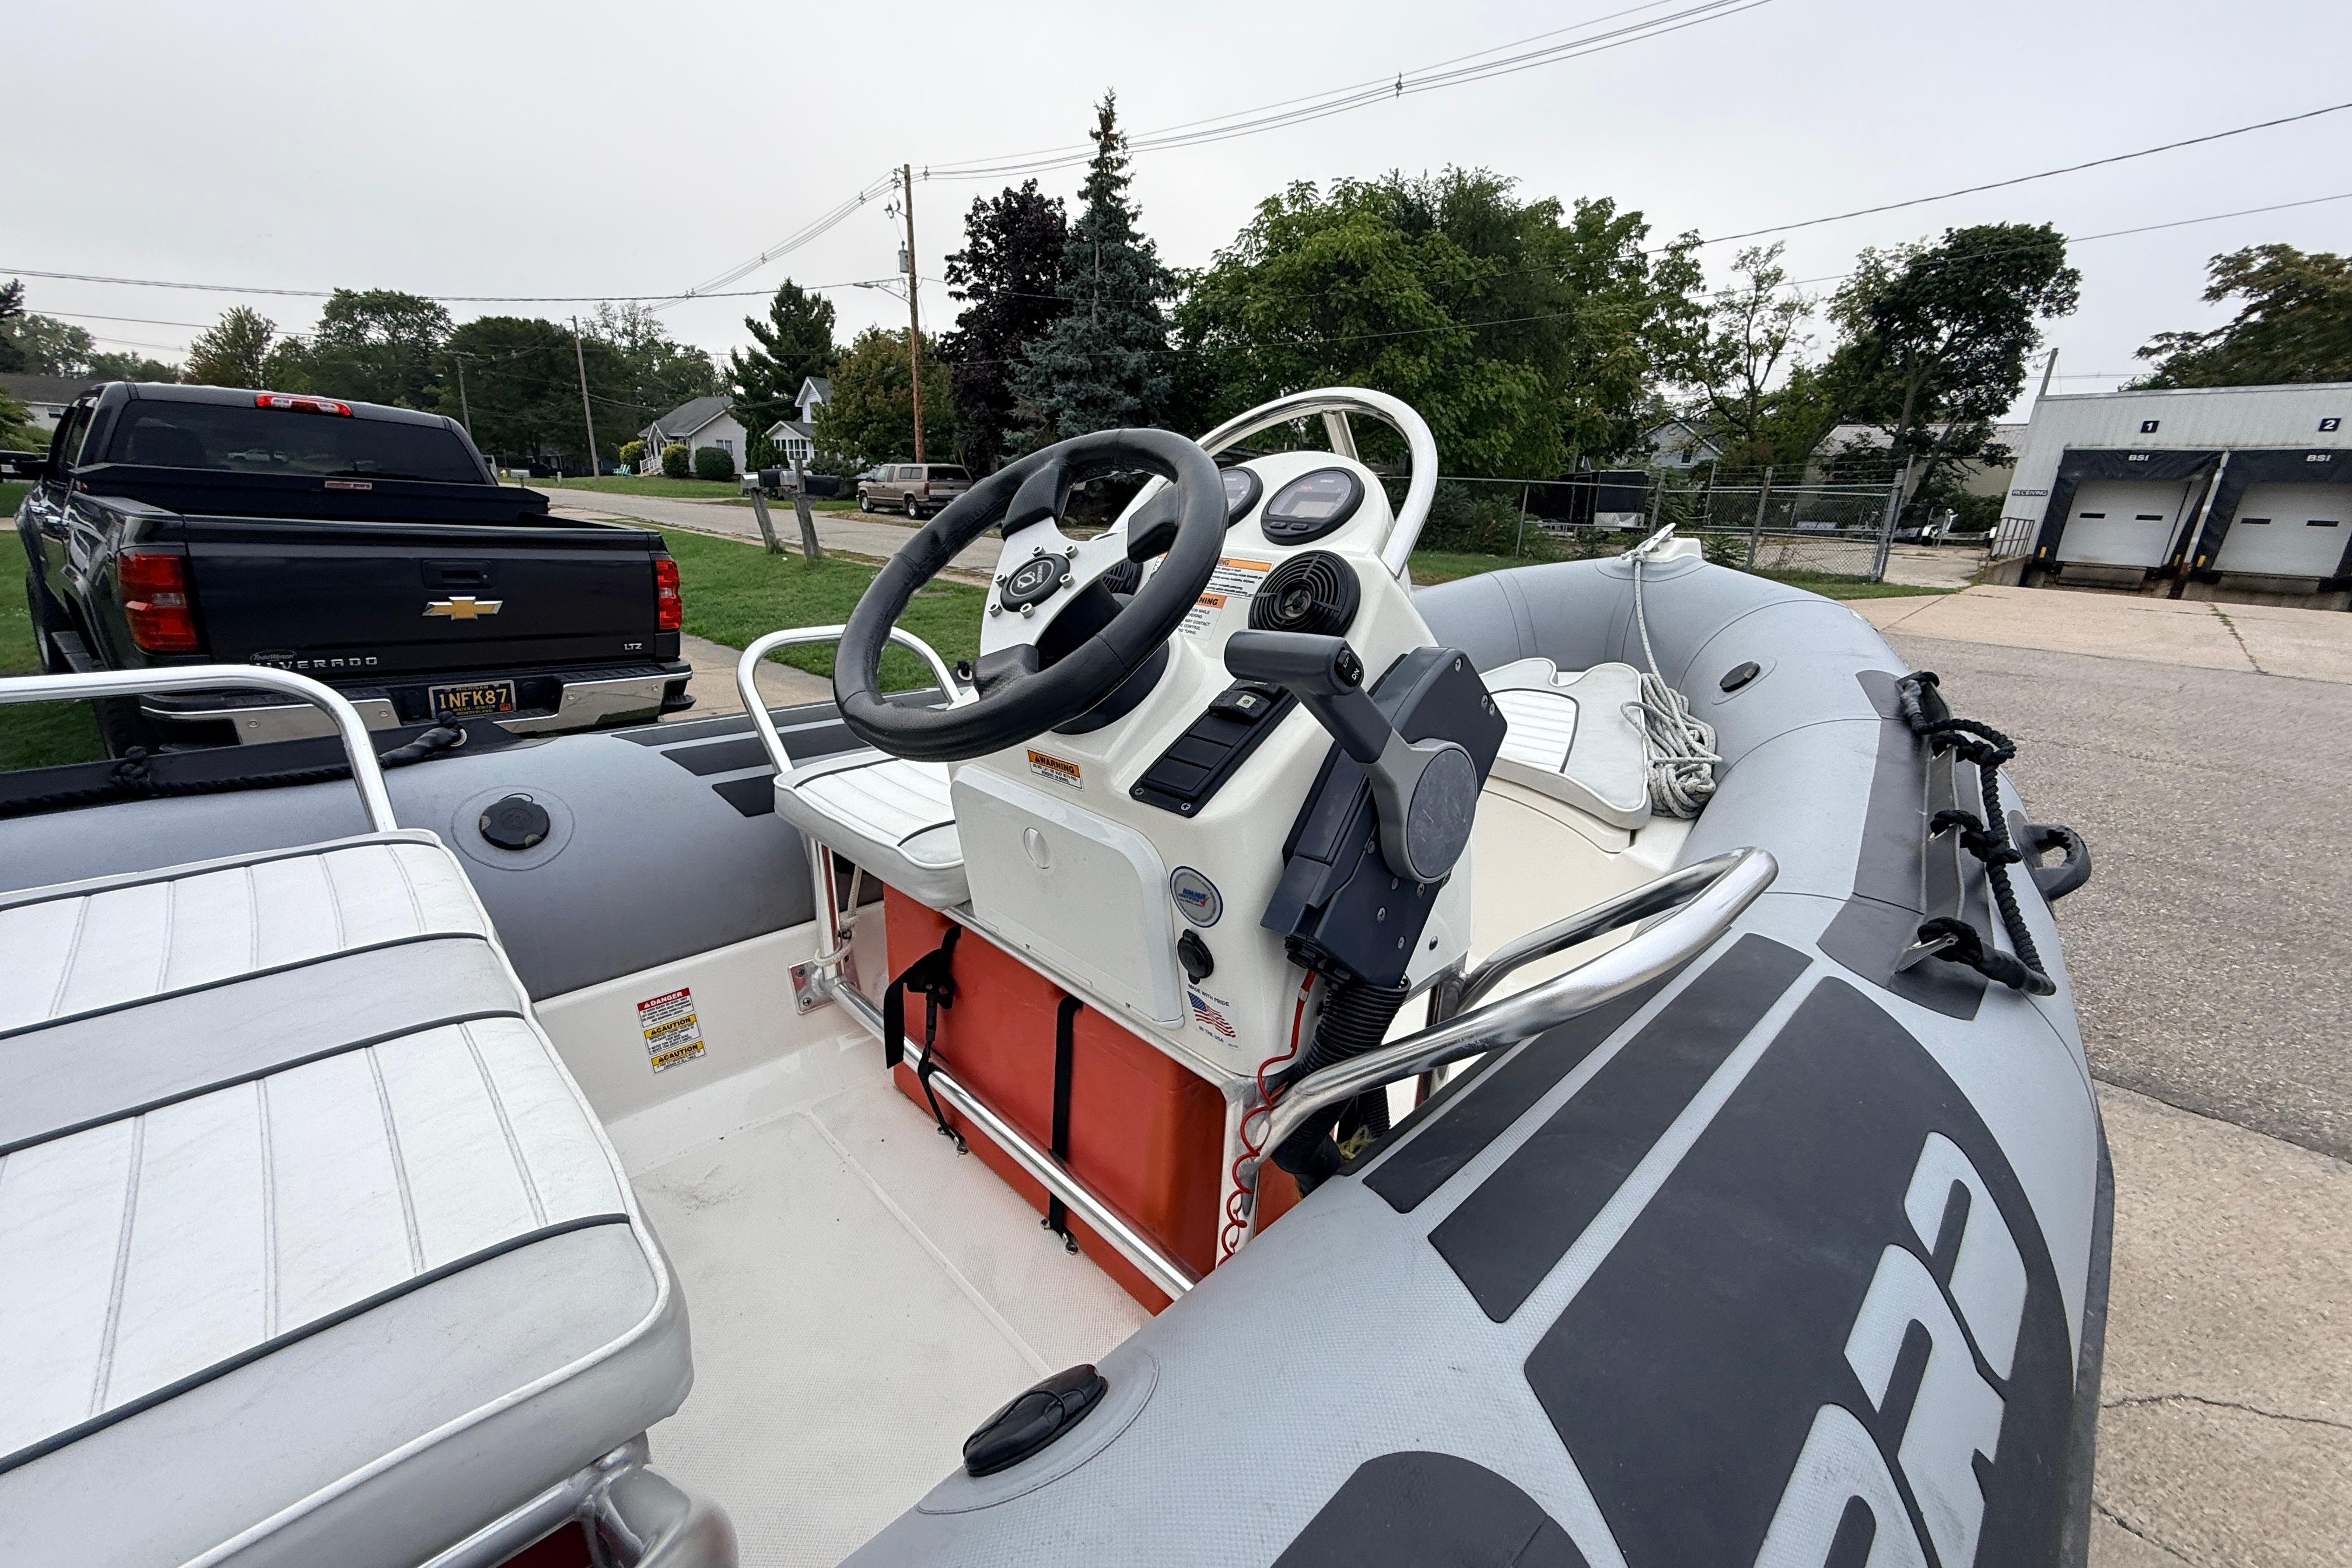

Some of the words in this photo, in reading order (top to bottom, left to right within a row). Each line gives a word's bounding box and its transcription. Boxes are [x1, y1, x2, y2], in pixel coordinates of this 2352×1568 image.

[2147, 422, 2154, 431] 1
[2323, 420, 2336, 430] 2
[1352, 668, 1360, 680] DN
[439, 688, 507, 709] 1NFK87
[1039, 756, 1074, 774] WARNING
[650, 992, 683, 1006] DANGER
[1188, 984, 1200, 995] MADE
[1202, 990, 1213, 1001] WITH
[1214, 997, 1230, 1007] PRIDE
[656, 1017, 691, 1033] CAUTION
[1205, 1029, 1213, 1038] THE
[1214, 1034, 1224, 1043] USA
[663, 1044, 698, 1060] CAUTION
